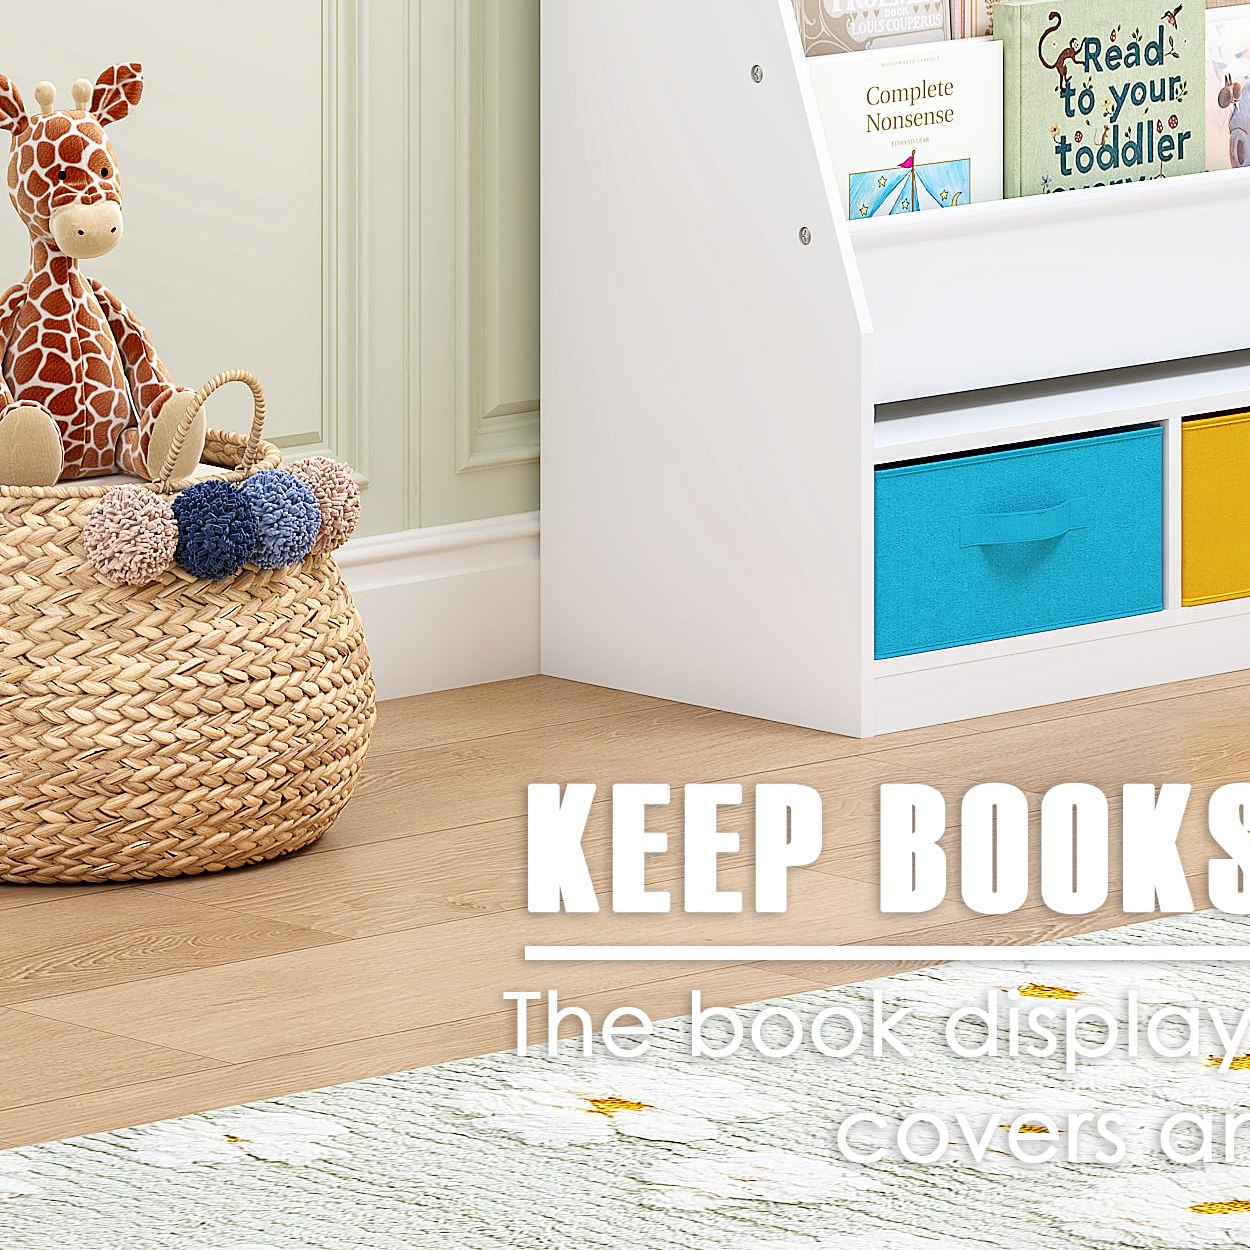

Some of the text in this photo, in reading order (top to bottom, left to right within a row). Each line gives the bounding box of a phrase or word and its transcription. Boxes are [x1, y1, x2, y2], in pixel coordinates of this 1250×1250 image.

[884, 7, 909, 18] DOOR
[1084, 25, 1164, 73] Read
[866, 80, 953, 106] Complete
[1059, 75, 1181, 123] to your
[866, 108, 954, 133] Nonsense
[1055, 120, 1192, 176] toddler
